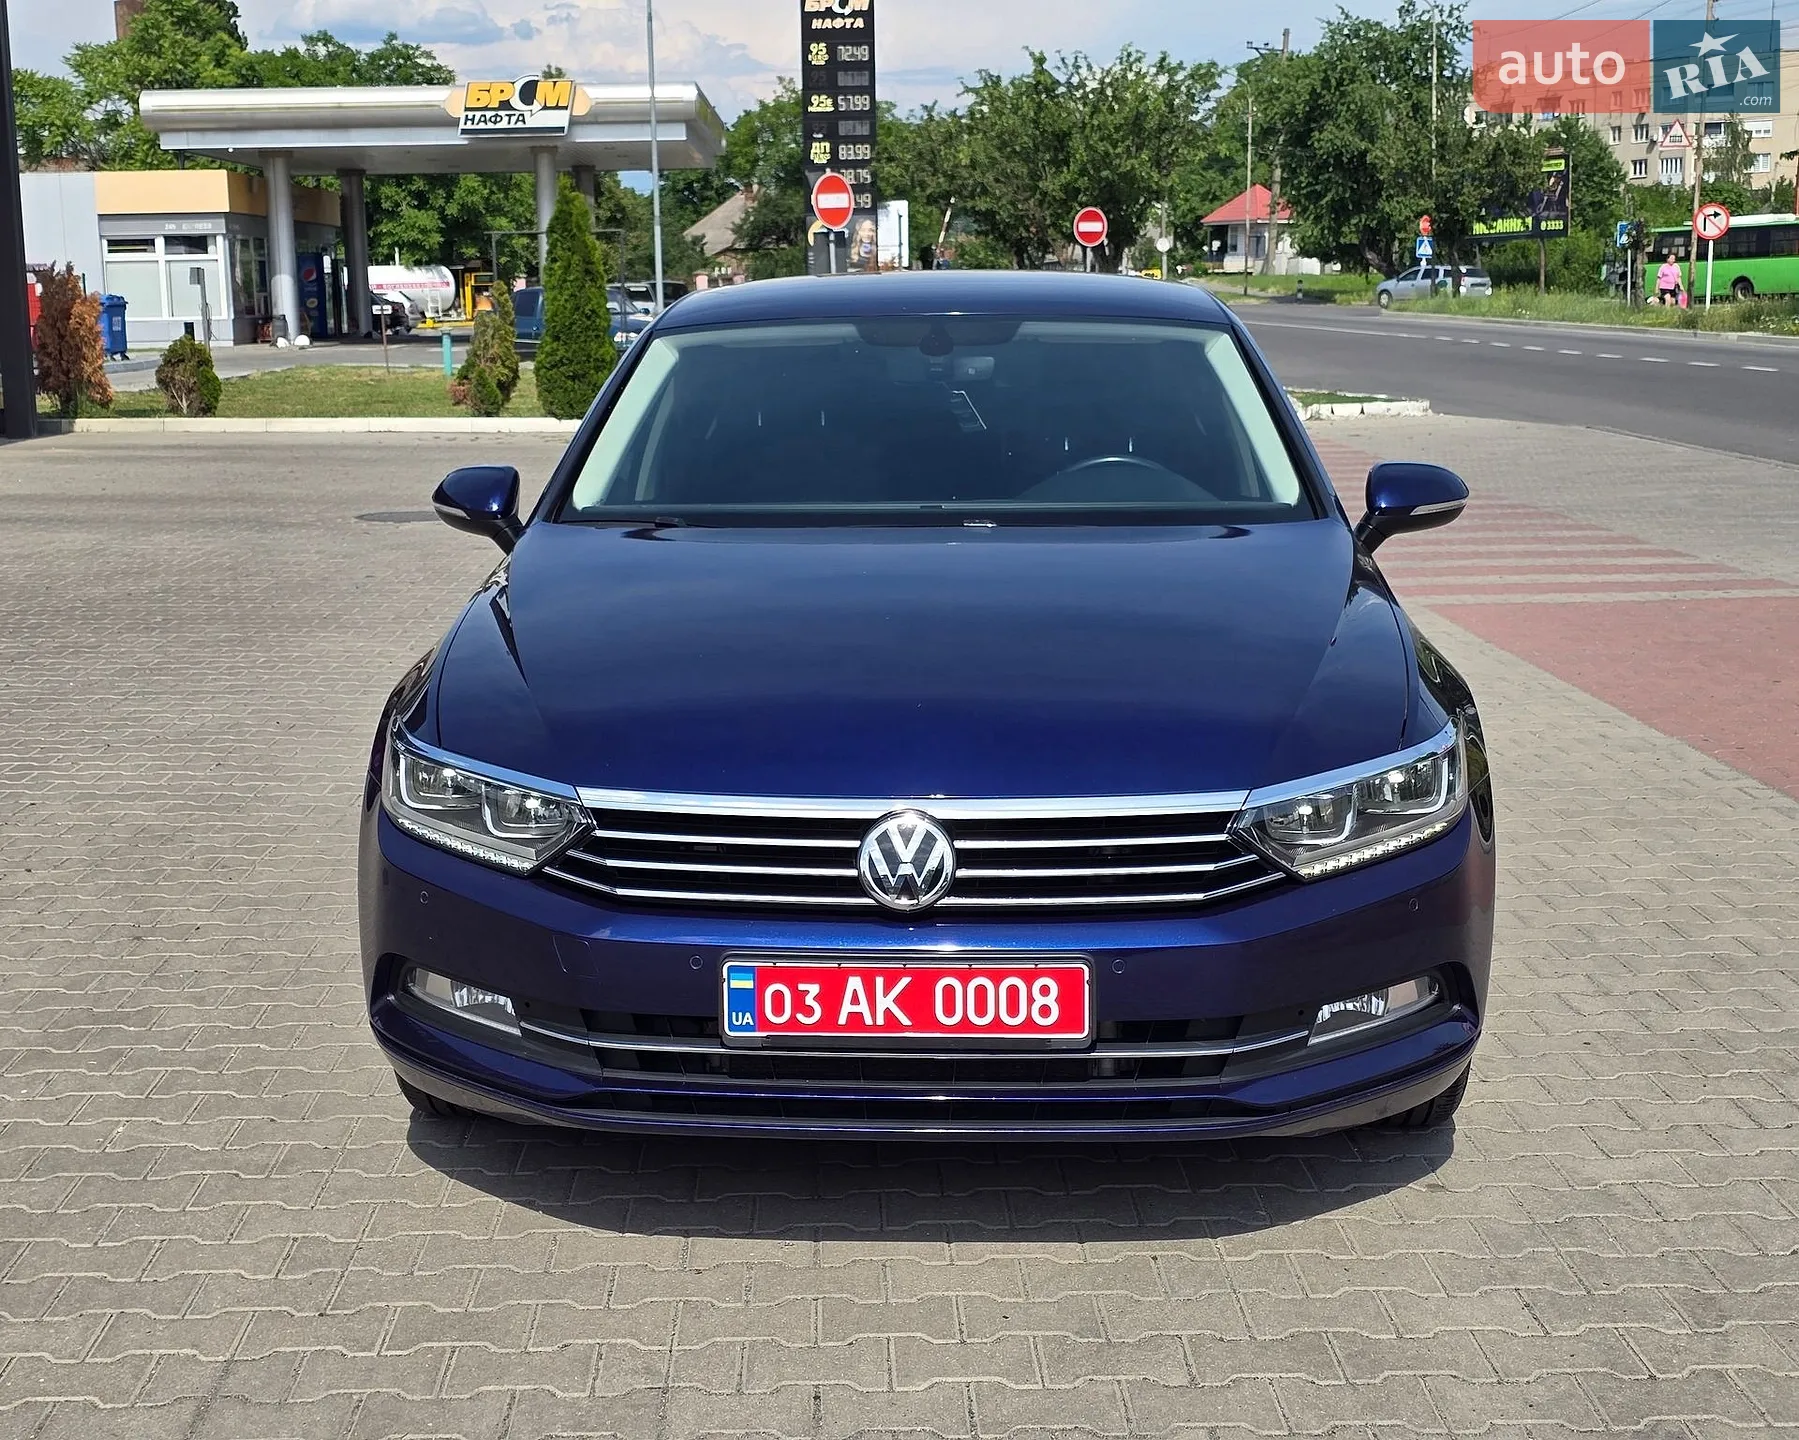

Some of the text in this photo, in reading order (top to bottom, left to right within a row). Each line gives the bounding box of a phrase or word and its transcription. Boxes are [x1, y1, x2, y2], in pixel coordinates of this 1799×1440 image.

[811, 17, 865, 29] НАФТА
[809, 42, 827, 56] 95
[466, 75, 572, 114] БРСМ
[463, 113, 527, 126] НАФТА
[763, 975, 1060, 1027] 03 AK 0008
[731, 1011, 755, 1026] UA
